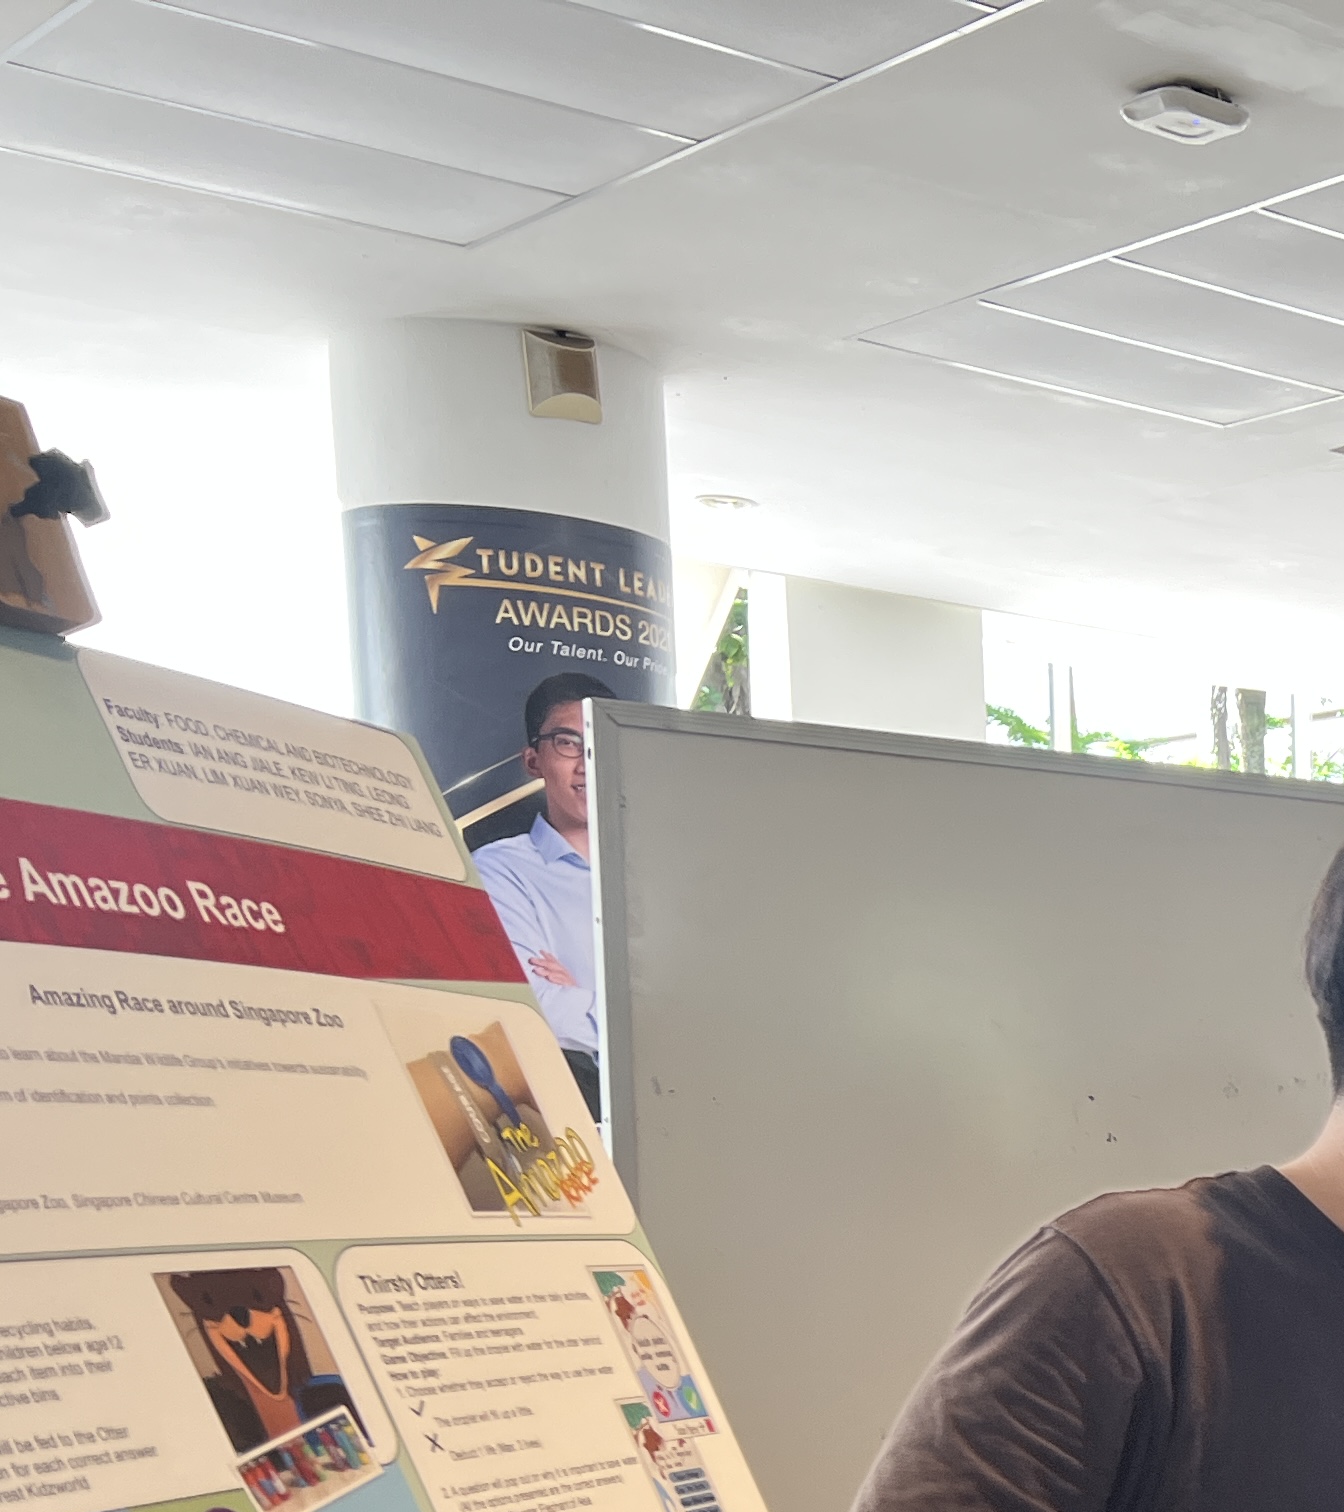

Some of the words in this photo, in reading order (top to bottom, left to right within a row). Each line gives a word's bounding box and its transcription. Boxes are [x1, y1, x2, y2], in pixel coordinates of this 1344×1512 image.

[495, 599, 632, 641] AWARDS
[508, 637, 543, 653] Our
[550, 640, 608, 662] Talent.
[614, 650, 639, 668] Our
[213, 725, 282, 756] CHEMICAL
[284, 741, 314, 763] AND
[127, 751, 151, 770] ER
[200, 767, 228, 786] LIM
[229, 774, 271, 796] XUAN
[351, 801, 390, 824] SHEE
[389, 811, 411, 831] ZHI
[409, 817, 443, 838] LIANG
[217, 749, 247, 769] ANG
[287, 766, 319, 786] KEW
[366, 785, 411, 810] LEONG
[17, 856, 187, 923] Amazoo
[186, 878, 286, 934] Race
[28, 984, 118, 1016] Amazing
[114, 990, 164, 1014] Race
[168, 997, 231, 1019] around
[230, 999, 313, 1028] Singapore
[314, 1007, 344, 1028] Zoo
[356, 1273, 417, 1296] Thirsty
[42, 1341, 83, 1356] below
[27, 1366, 59, 1380] item
[56, 1363, 84, 1376] into
[13, 1438, 35, 1453] be
[33, 1433, 58, 1449] fed
[57, 1432, 74, 1447] to
[72, 1430, 97, 1445] the
[96, 1426, 129, 1441] Otter
[10, 1462, 30, 1477] for
[33, 1457, 68, 1474] each
[68, 1451, 114, 1469] correct
[114, 1446, 159, 1462] answer
